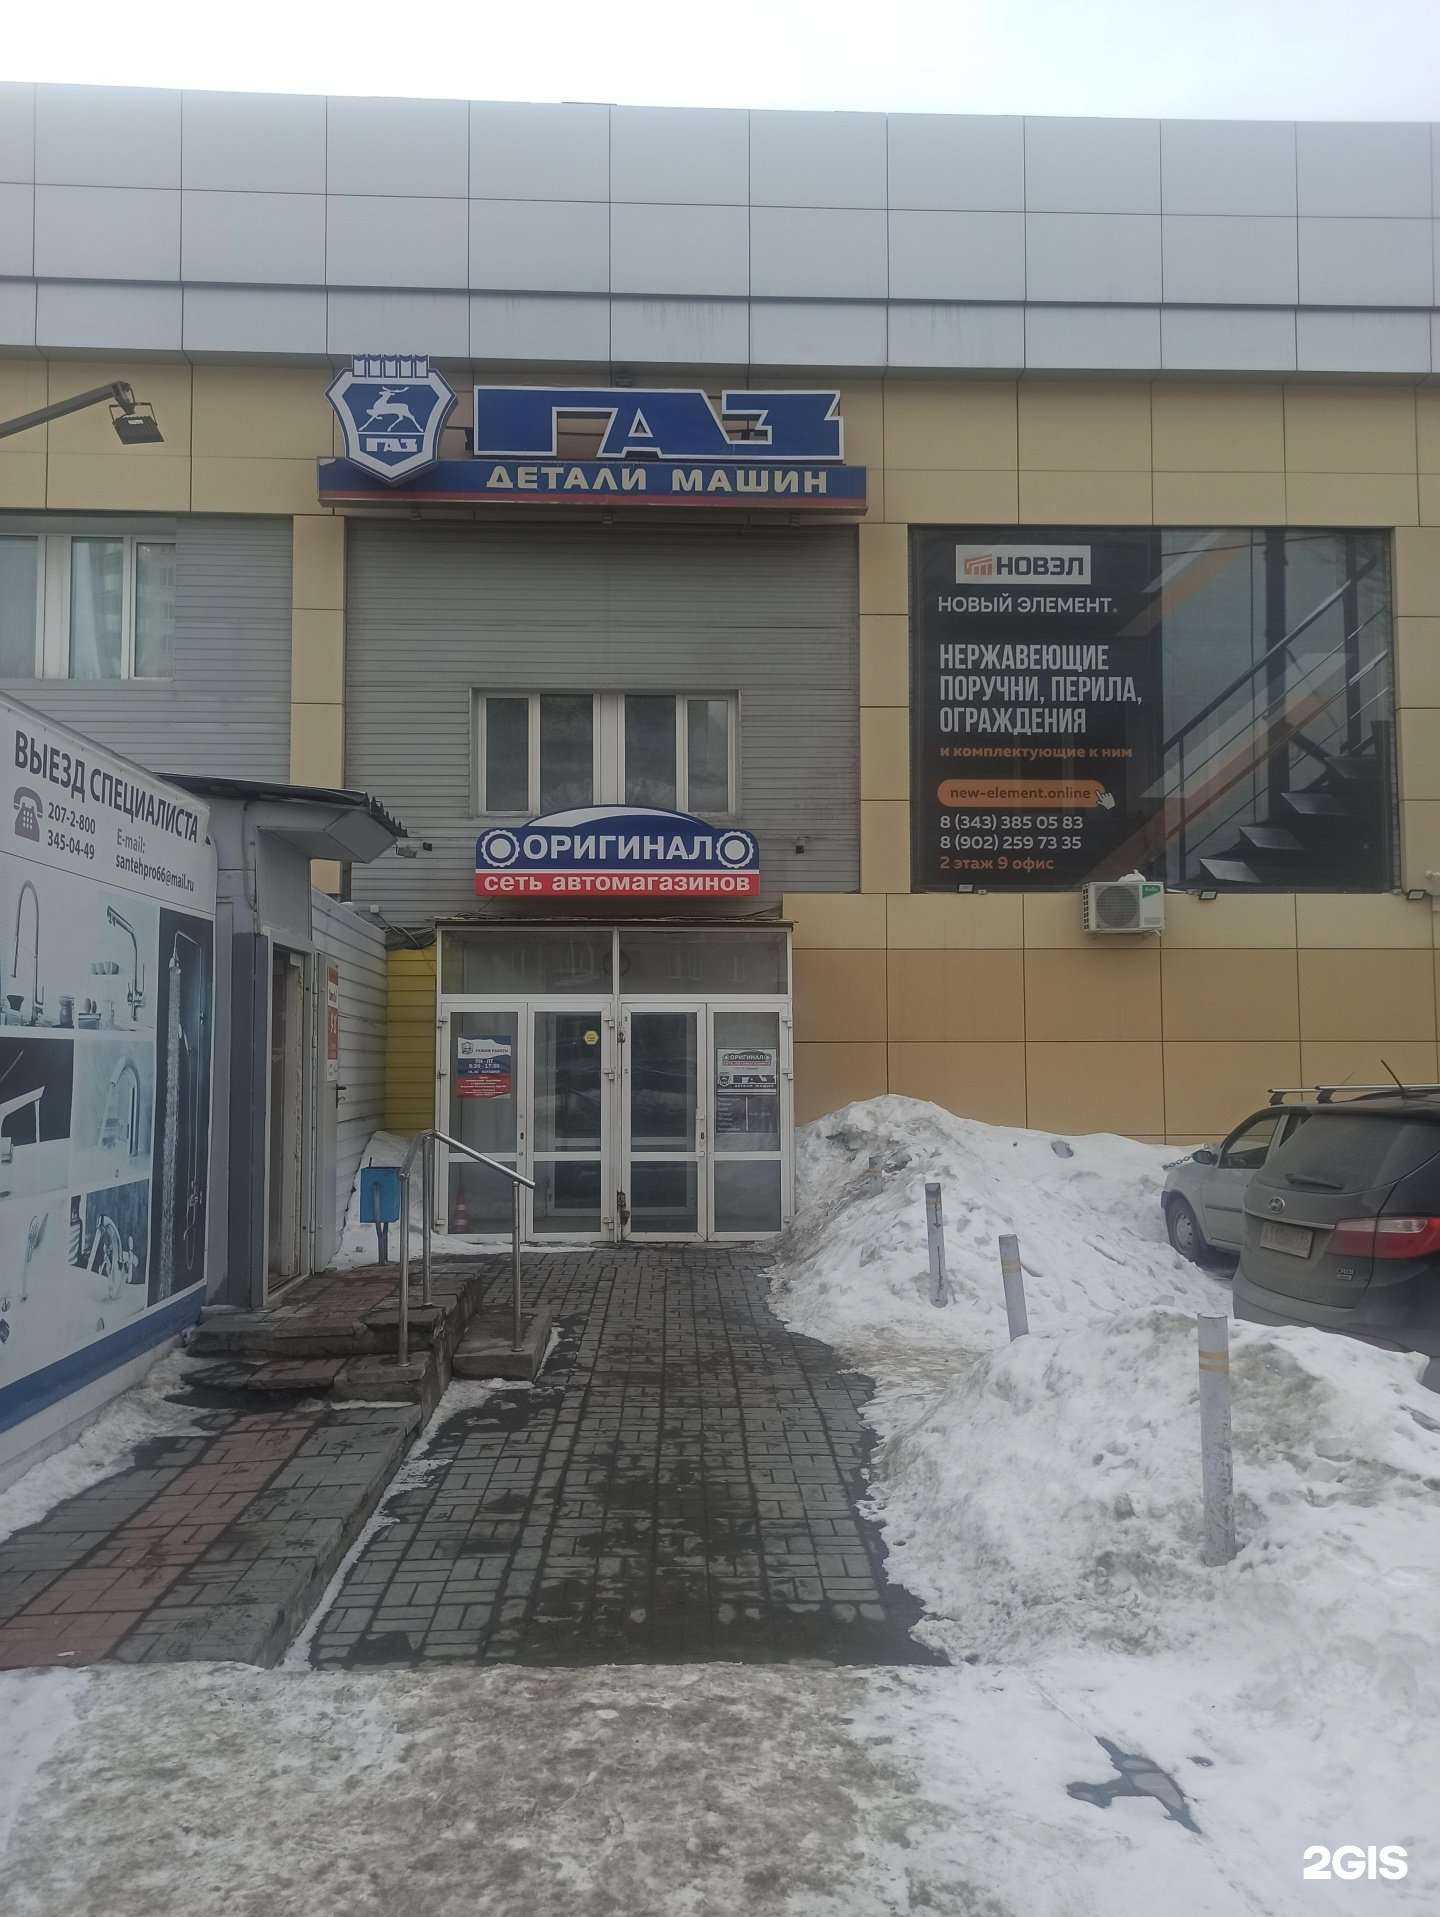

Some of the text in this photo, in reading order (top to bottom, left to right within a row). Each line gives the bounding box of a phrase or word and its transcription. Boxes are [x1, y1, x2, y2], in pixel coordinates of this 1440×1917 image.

[473, 385, 844, 460] ГАЗ
[366, 437, 418, 453] ГАЗ
[486, 466, 828, 493] ДЕТАЛИ МАШИН
[996, 556, 1084, 576] НОВЭЛ
[937, 593, 1013, 613] НОВЫЙ
[939, 644, 1109, 672] НЕРЖАВЕЮЩИЕ
[939, 676, 1142, 705] ПОРУЧНИ, ПЕРИЛА,
[939, 707, 1087, 735] ОГРАЖДЕНИЯ
[940, 748, 1133, 761] и комплектующие к ним
[15, 730, 199, 843] ВЫЕЗД СПЕЦИАЛИСТА
[950, 786, 1091, 799] new-element.online
[48, 802, 96, 835] 207-2-800
[940, 814, 1084, 831] 8 (343) 385 05 83
[47, 830, 95, 860] 345-04-49
[117, 828, 146, 854] E-mail:
[523, 835, 713, 860] ОРИГИНАЛ
[940, 834, 1082, 851] 8 (902) 259 73 35
[115, 854, 194, 892] santehpro66@mail.ru
[940, 857, 1055, 872] 2 этаж 9 офис
[484, 876, 750, 891] сеть автомагазинов
